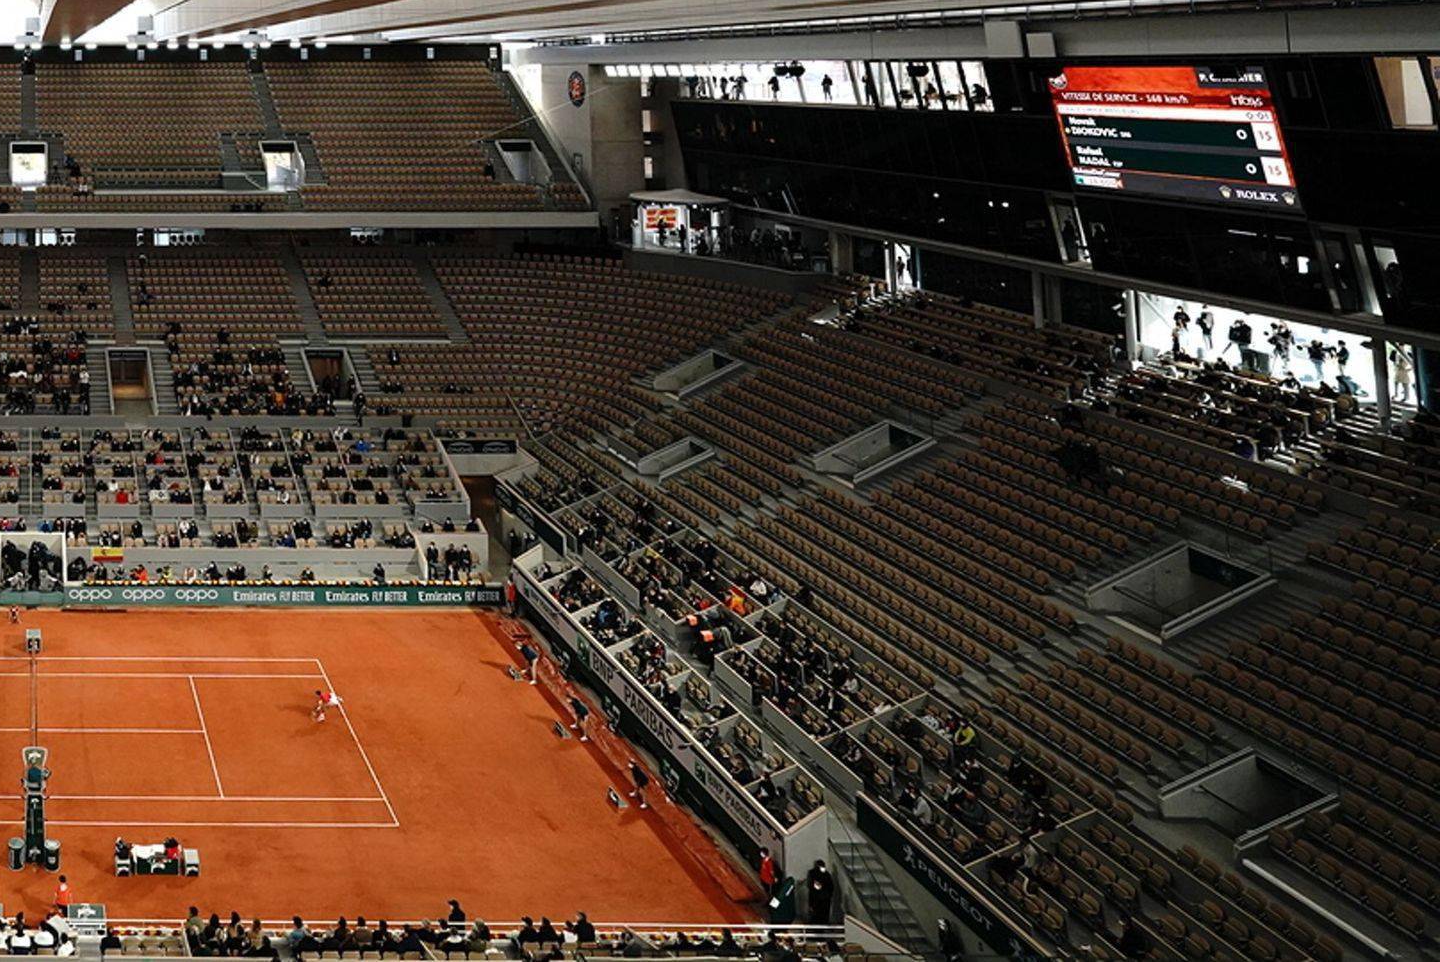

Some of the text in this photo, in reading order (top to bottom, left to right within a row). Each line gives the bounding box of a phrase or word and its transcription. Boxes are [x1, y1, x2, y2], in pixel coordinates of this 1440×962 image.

[1236, 189, 1278, 203] ROLEX
[233, 590, 277, 602] Emirates
[325, 590, 370, 602] Emirates
[417, 590, 462, 602] Emirates
[477, 591, 500, 601] BETTER
[592, 651, 675, 749] BNP PARIBAS
[918, 858, 994, 931] PEUGEOT
